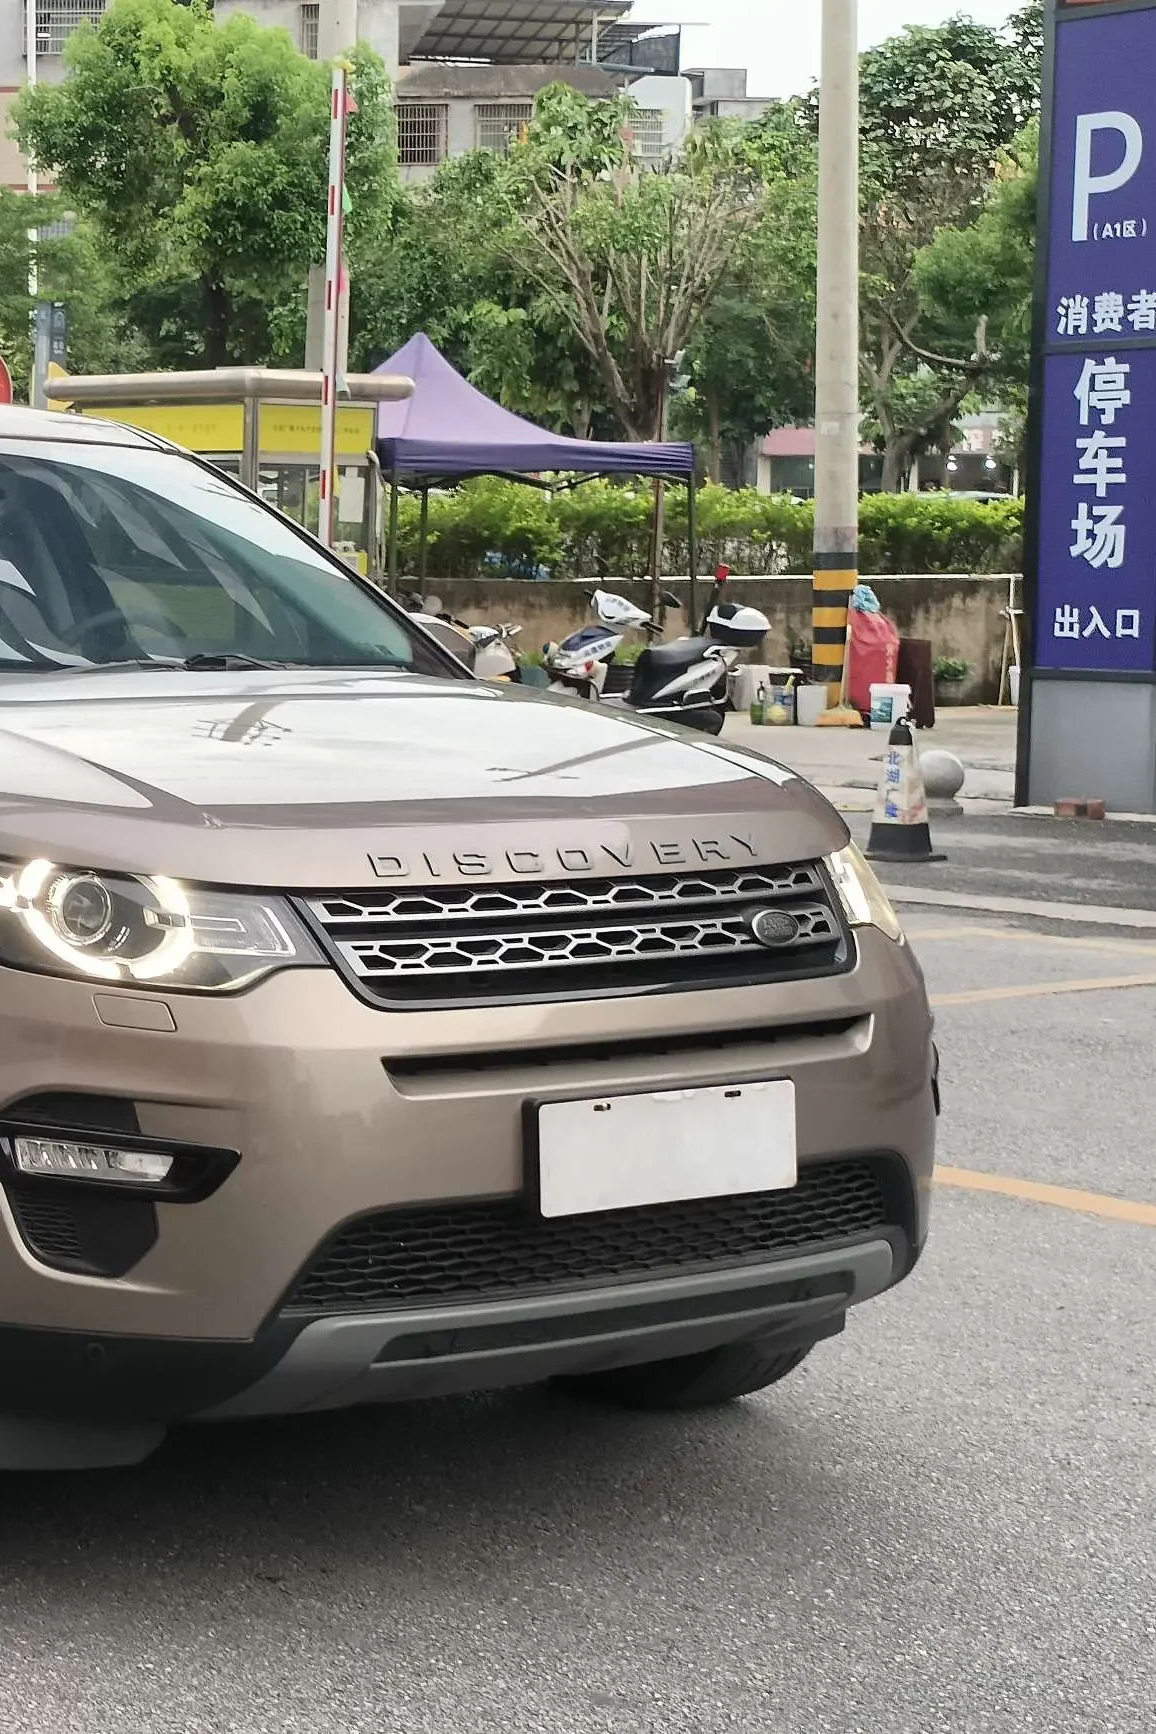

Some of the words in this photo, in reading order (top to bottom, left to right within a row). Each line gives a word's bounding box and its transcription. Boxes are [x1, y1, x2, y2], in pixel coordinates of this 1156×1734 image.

[1072, 111, 1142, 242] P
[1056, 289, 1156, 335] 消费者
[1069, 356, 1131, 569] 停车场
[1053, 604, 1141, 640] 出入口
[366, 833, 760, 878] DISCOVERY
